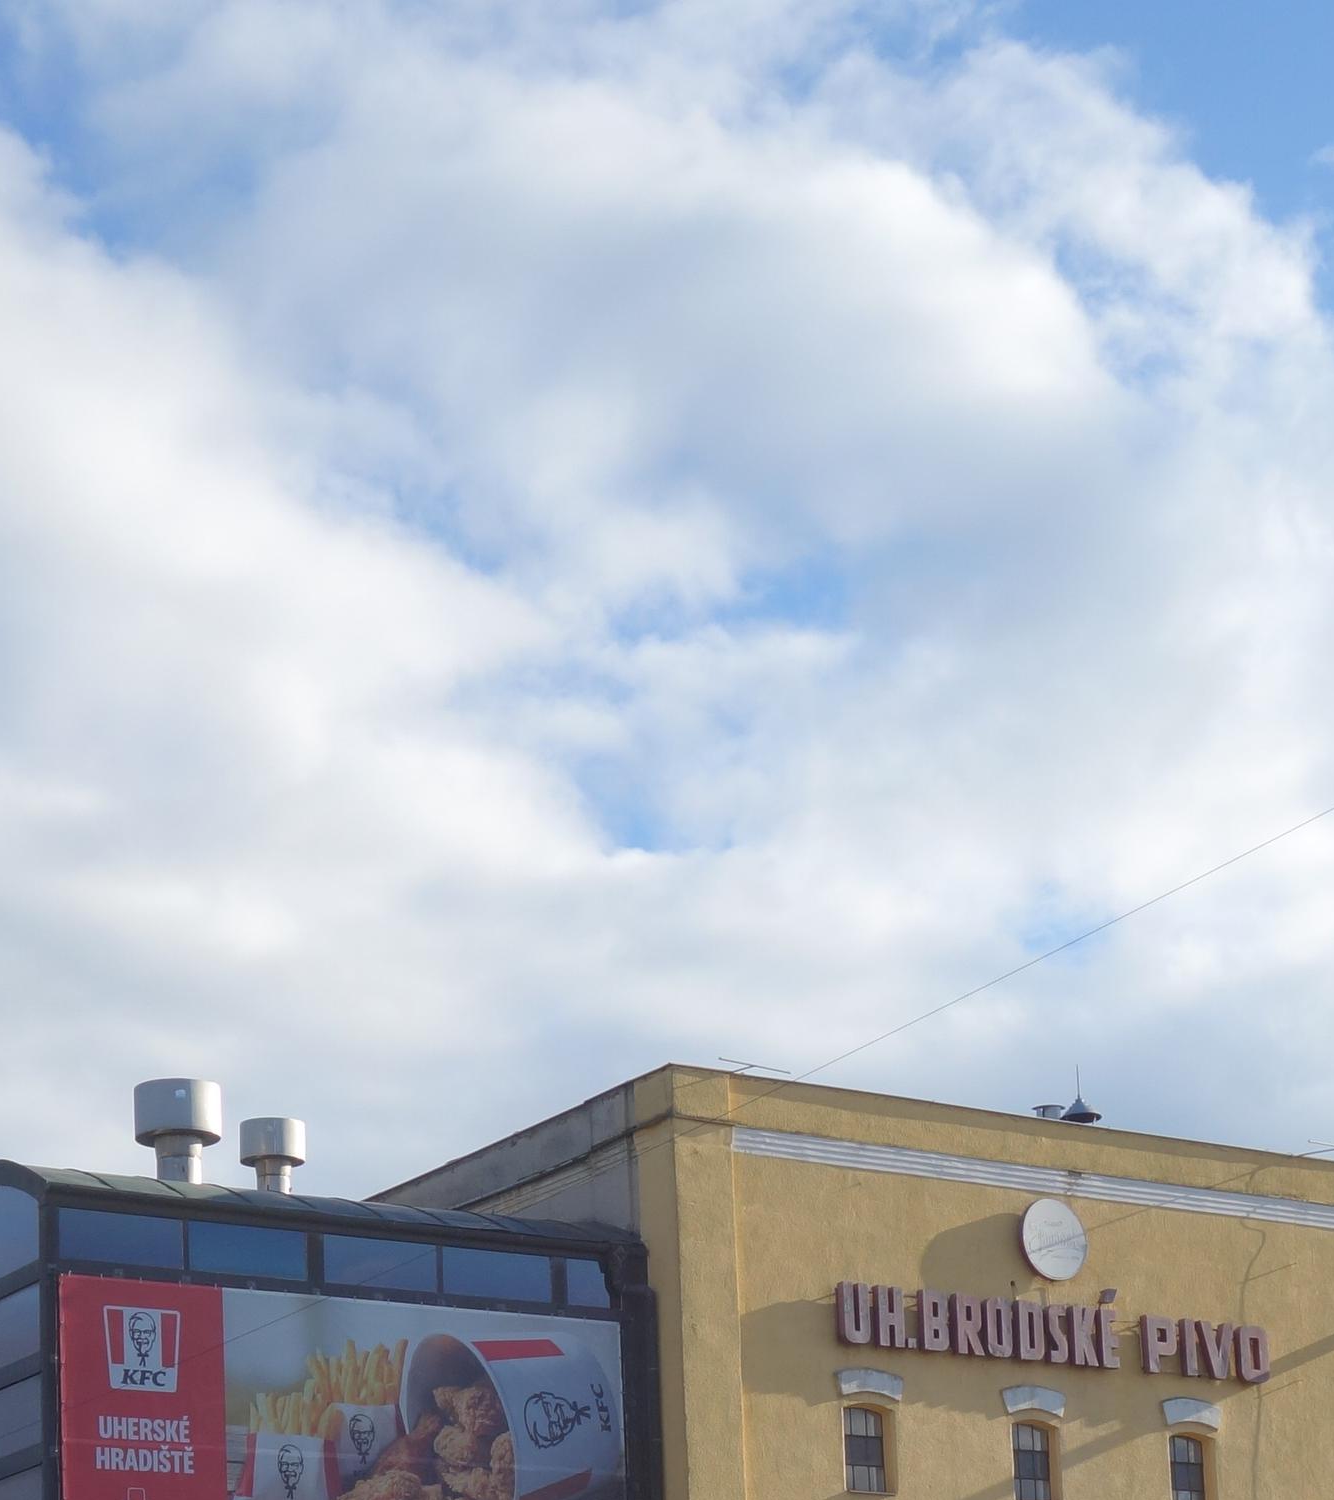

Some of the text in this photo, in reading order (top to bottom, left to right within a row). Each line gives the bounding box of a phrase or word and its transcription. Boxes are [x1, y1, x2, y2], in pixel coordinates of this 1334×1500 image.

[1139, 1313, 1271, 1384] PIVO
[120, 1368, 167, 1387] KFC
[590, 1383, 612, 1432] KFC
[98, 1415, 191, 1444] UHERSKÉ
[95, 1445, 195, 1474] HRADIŠTĚ
